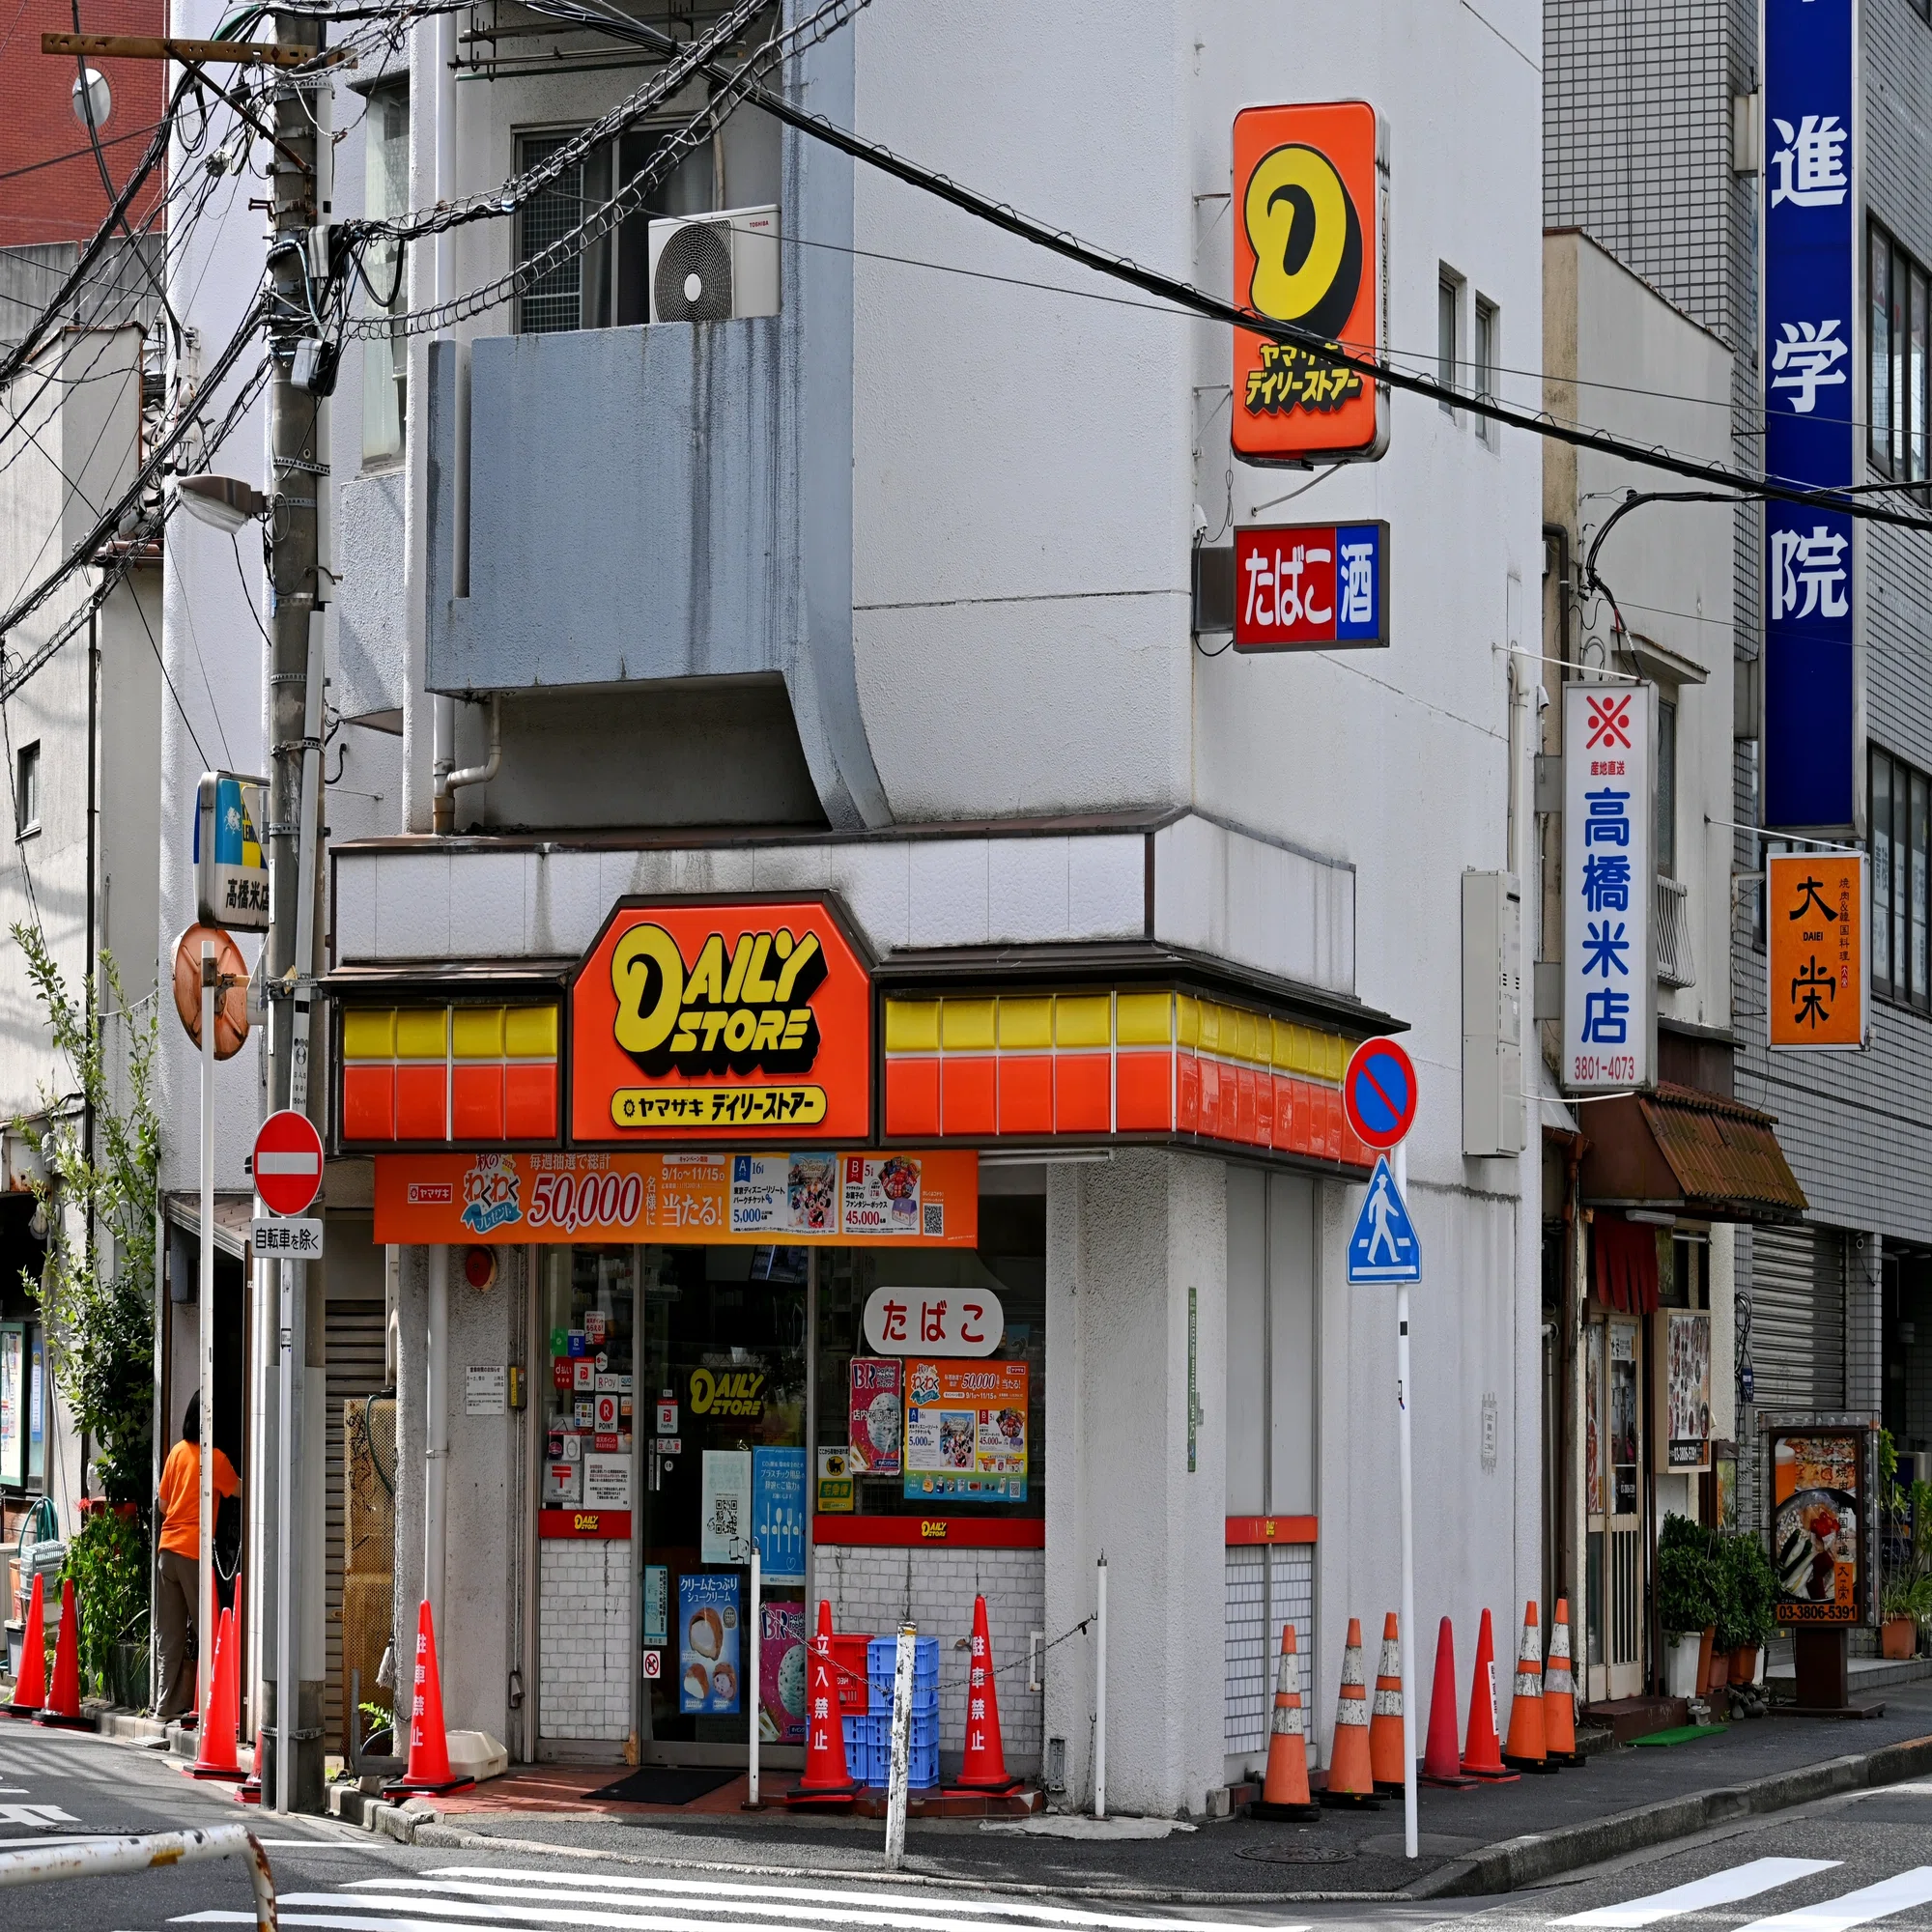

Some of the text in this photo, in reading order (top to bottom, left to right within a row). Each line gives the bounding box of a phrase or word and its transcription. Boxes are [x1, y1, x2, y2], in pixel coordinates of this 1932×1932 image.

[1771, 0, 1848, 620] 進学院
[1246, 368, 1359, 405] デイリーストアー
[1245, 543, 1374, 627] たばこ 酒
[1590, 760, 1626, 776] 産地直送
[226, 878, 270, 912] 高橋米店
[1581, 786, 1631, 1044] 高橋米店
[1803, 931, 1824, 942] DAIEI
[611, 923, 819, 1053] DAILY
[669, 1009, 811, 1052] STORE
[1574, 1055, 1635, 1081] 3801-4073
[639, 1092, 814, 1122] ヤマザキ デイリーストアー
[477, 1153, 498, 1172] 秋の
[502, 1158, 513, 1170] 2025
[529, 1153, 611, 1171] 毎週抽選で総計
[739, 1159, 747, 1172] A
[852, 1161, 859, 1174] B
[419, 1188, 450, 1199] ヤマザキ
[465, 1173, 520, 1208] わくわく
[733, 1185, 785, 1195] 東京ディズニーリゾート
[529, 1174, 640, 1231] 50,000
[645, 1175, 657, 1226] 名様に
[733, 1195, 765, 1204] パークチケット
[845, 1200, 888, 1208] ファンタジーボックス
[477, 1205, 512, 1230] プレゼント
[733, 1208, 761, 1224] 5,000
[256, 1227, 319, 1251] 自転車を除く
[882, 1299, 984, 1343] たばこ
[555, 1364, 572, 1375] d払い
[853, 1363, 876, 1389] BR
[912, 1375, 939, 1393] わくわく
[962, 1374, 996, 1389] 50,000
[690, 1368, 764, 1414] DAILY
[710, 1401, 761, 1415] STORE
[853, 1409, 898, 1423] 店内で販売中
[824, 1484, 849, 1496] 宅急便
[574, 1514, 599, 1530] DAILY
[921, 1520, 948, 1537] DAILY
[680, 1577, 738, 1592] クリームたっぷり
[687, 1592, 731, 1603] シュークリーム
[1778, 1605, 1856, 1620] 03-3806-5391
[412, 1633, 428, 1747] 駐車禁止
[813, 1634, 830, 1750] 立入禁止
[971, 1635, 985, 1750] 駐車禁止
